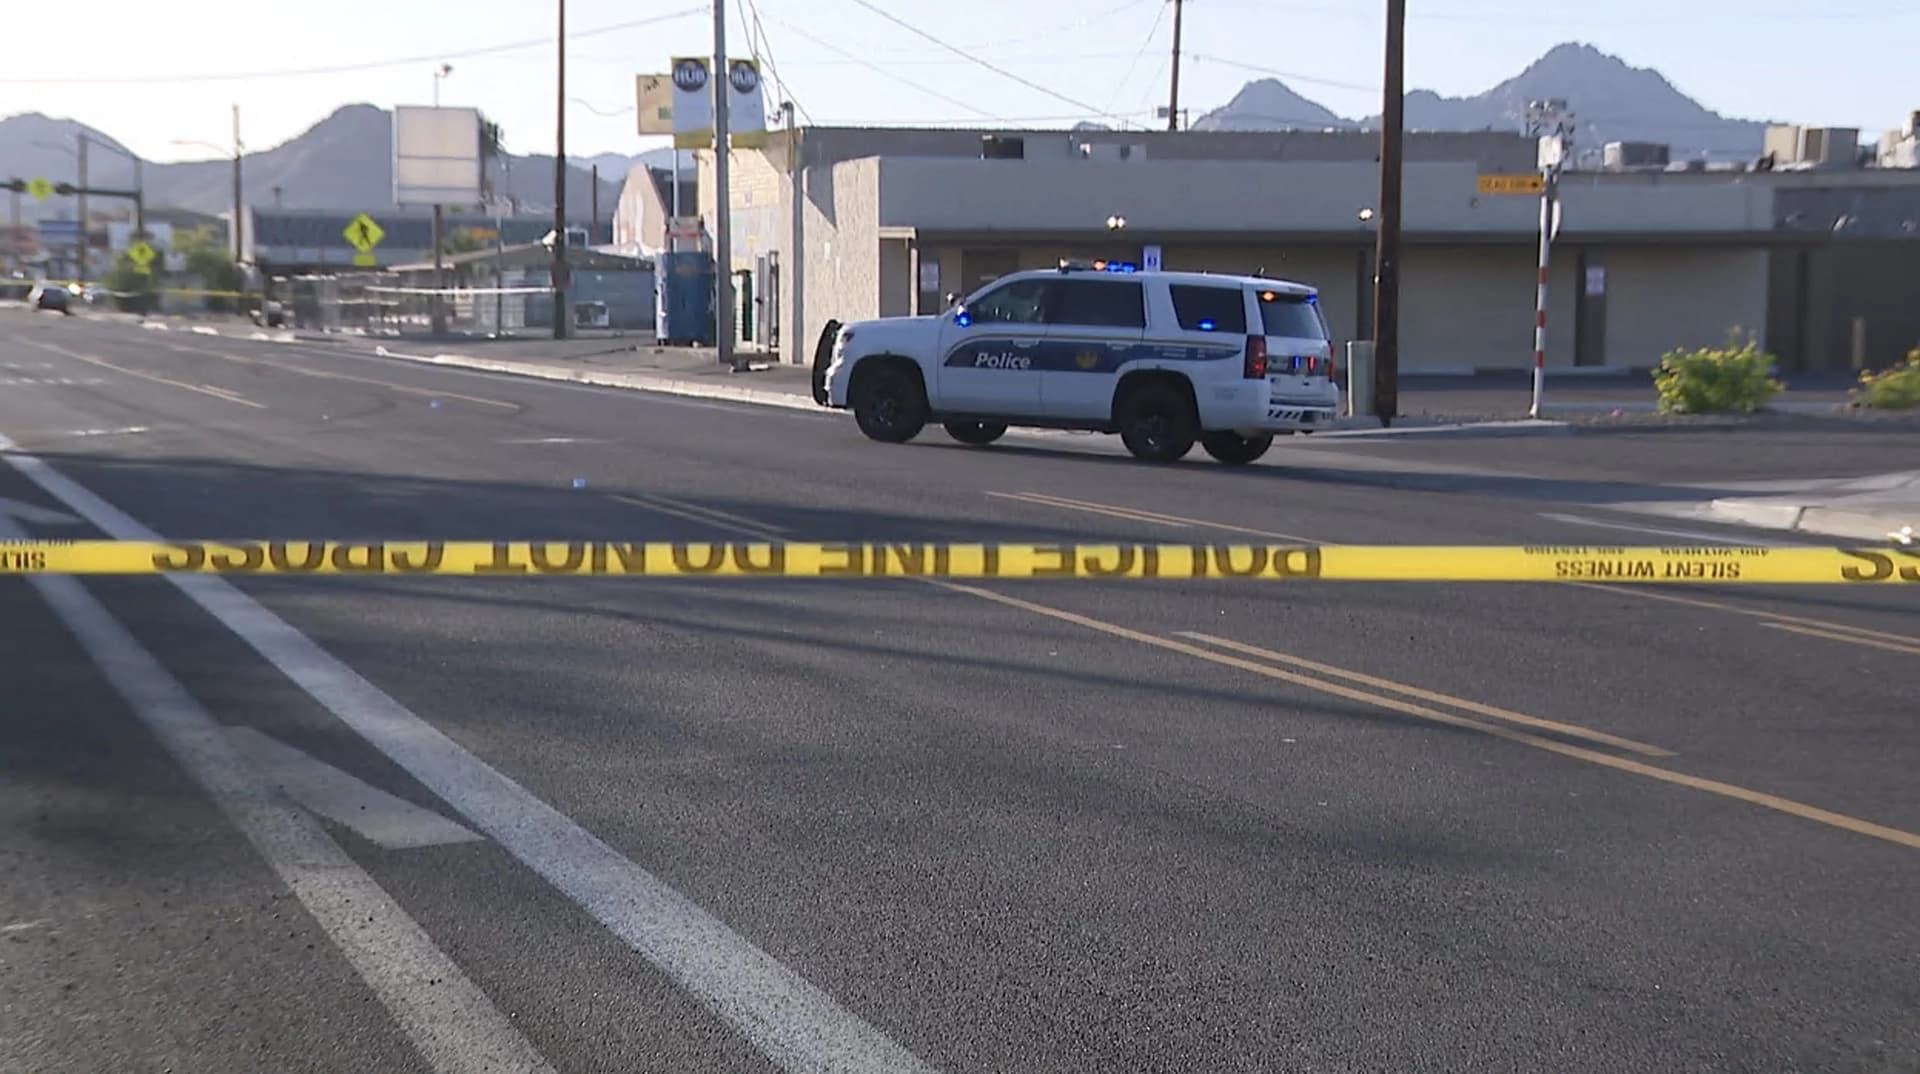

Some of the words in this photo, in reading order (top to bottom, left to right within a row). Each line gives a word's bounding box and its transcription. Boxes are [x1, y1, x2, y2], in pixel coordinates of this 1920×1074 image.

[976, 351, 1031, 369] Police
[819, 544, 999, 575] LINE
[1555, 561, 1655, 577] WITNESS
[1662, 561, 1740, 577] SILENT
